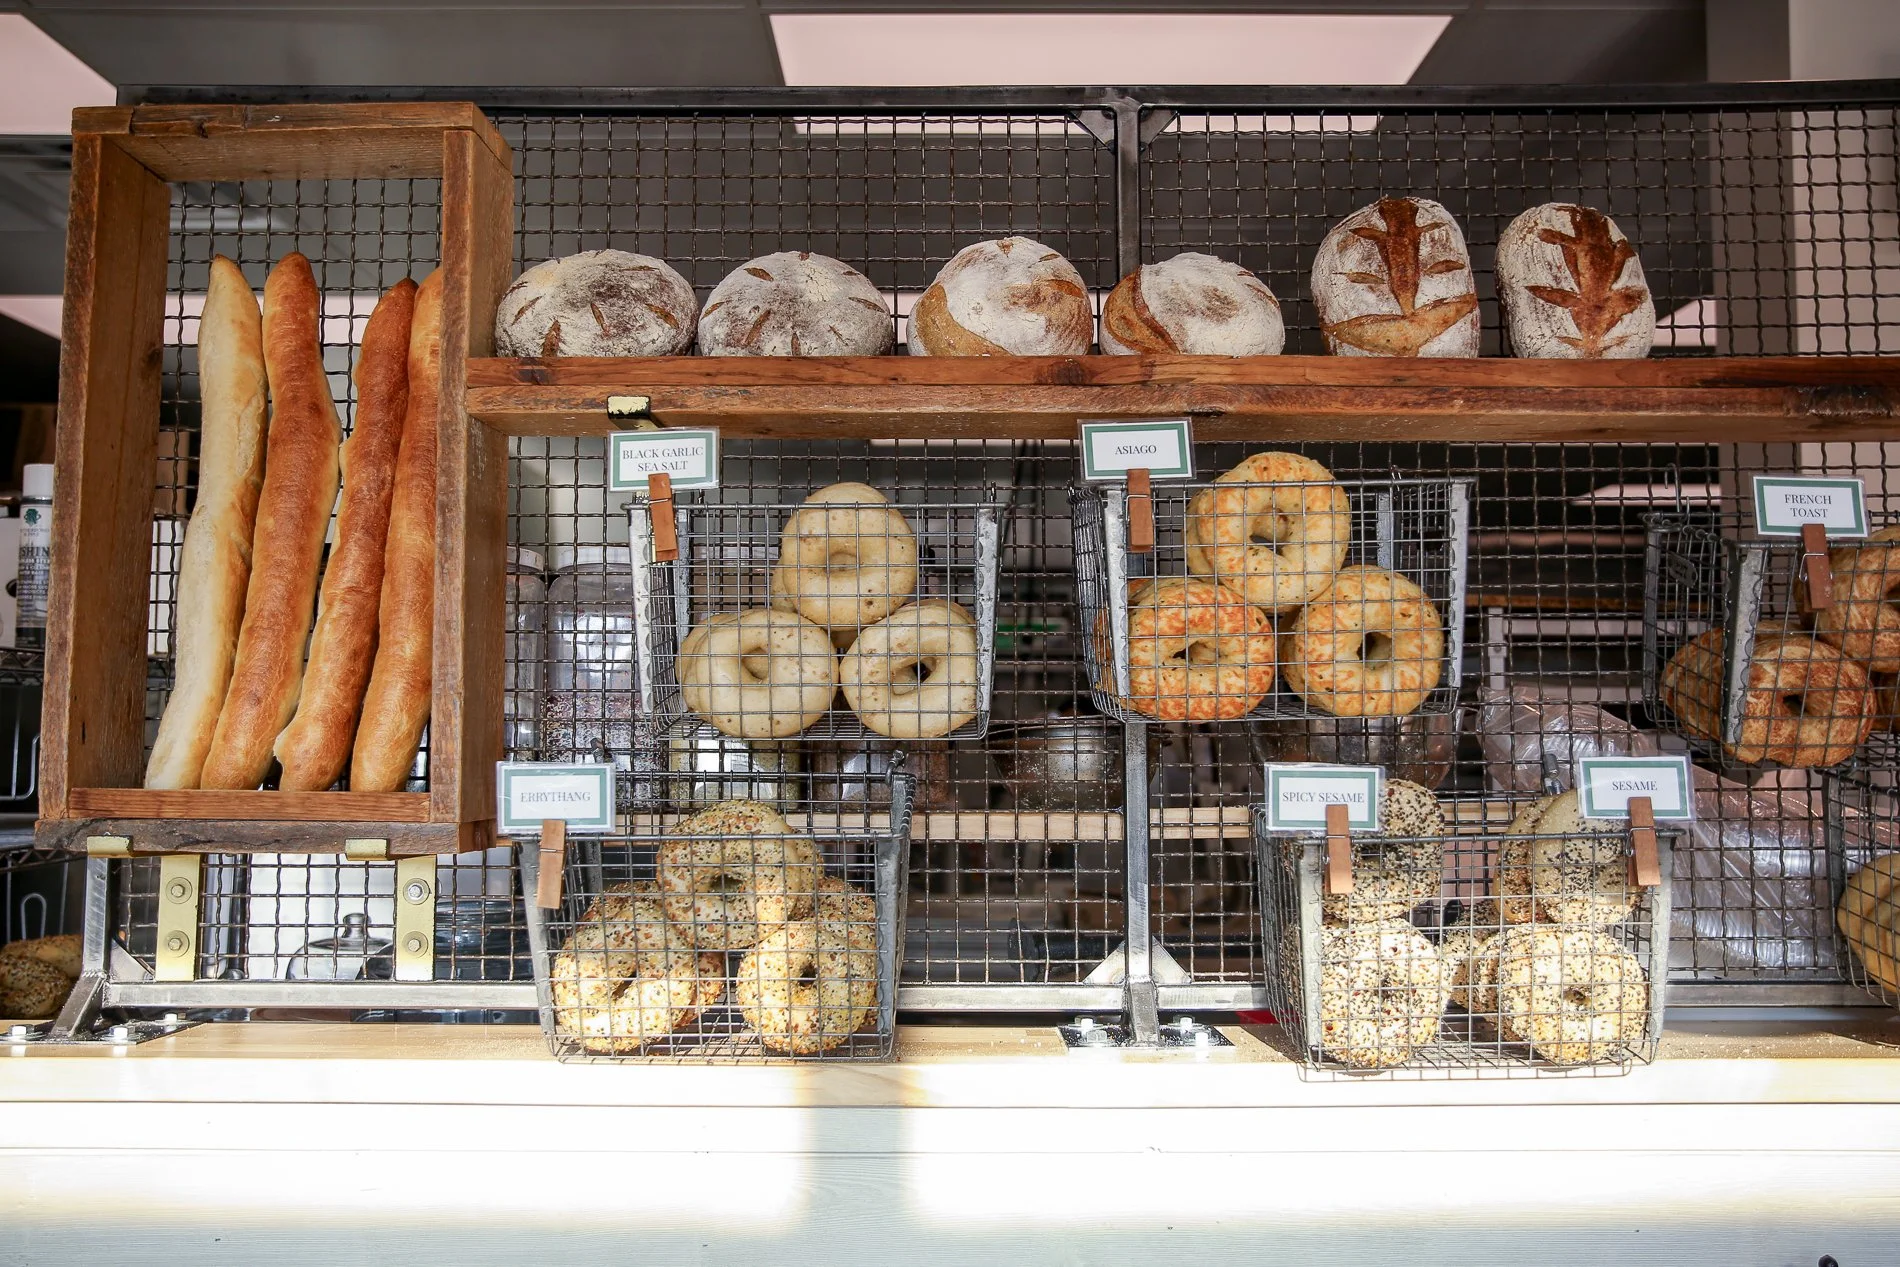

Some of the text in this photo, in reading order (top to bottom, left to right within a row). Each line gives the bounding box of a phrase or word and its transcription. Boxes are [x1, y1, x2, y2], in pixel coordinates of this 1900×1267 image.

[622, 446, 704, 460] BLACK GARLIC
[1115, 444, 1157, 455] ASIAGO
[637, 460, 688, 472] SEA SALT
[1784, 494, 1832, 505] FRENCH
[1790, 507, 1828, 518] TOAST
[1612, 780, 1658, 791] SESAME
[520, 791, 591, 802] ERRYTHANG
[1282, 792, 1364, 803] SPICY SESAME
